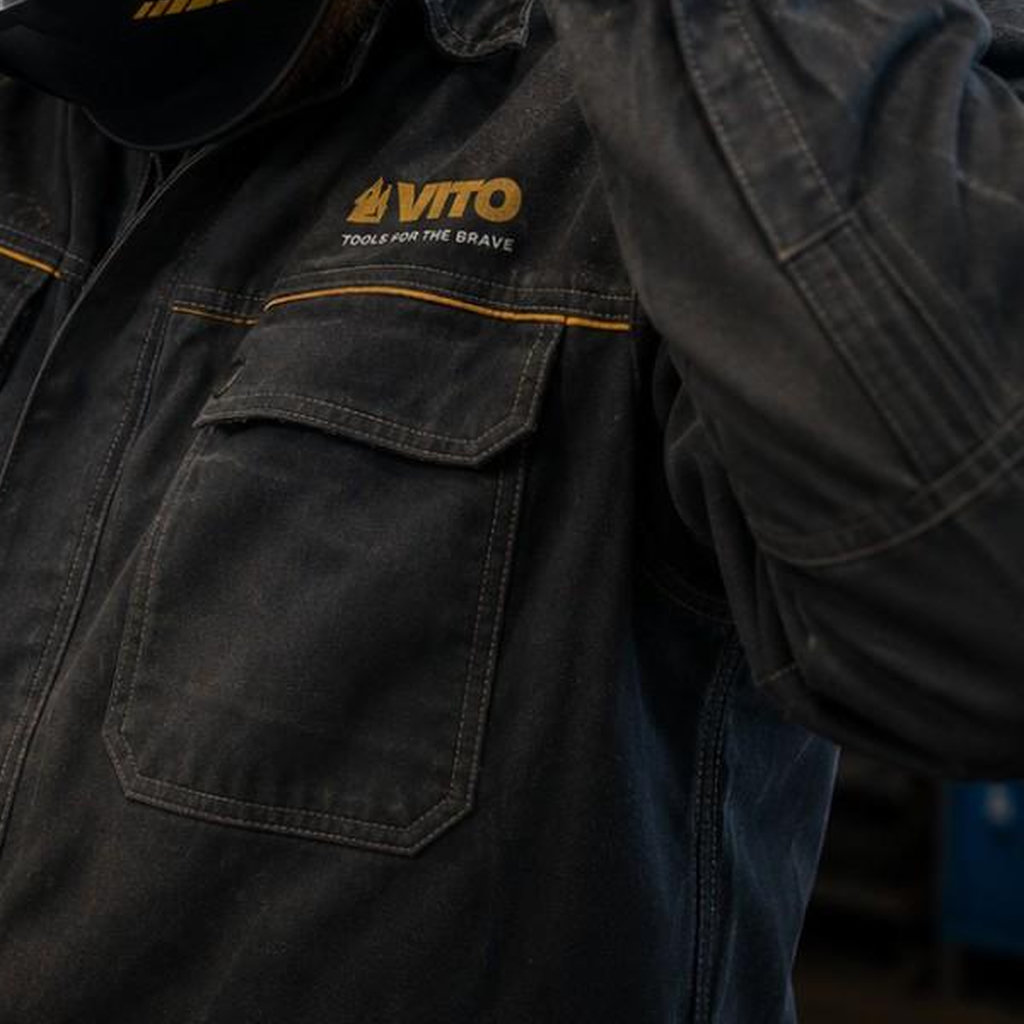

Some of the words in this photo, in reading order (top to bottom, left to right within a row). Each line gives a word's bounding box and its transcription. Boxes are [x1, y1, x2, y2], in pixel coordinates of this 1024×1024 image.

[397, 177, 522, 223] VITO
[341, 233, 389, 247] TOOLS
[390, 230, 418, 243] FOR
[423, 229, 452, 242] THE
[455, 229, 516, 252] BRAVE
